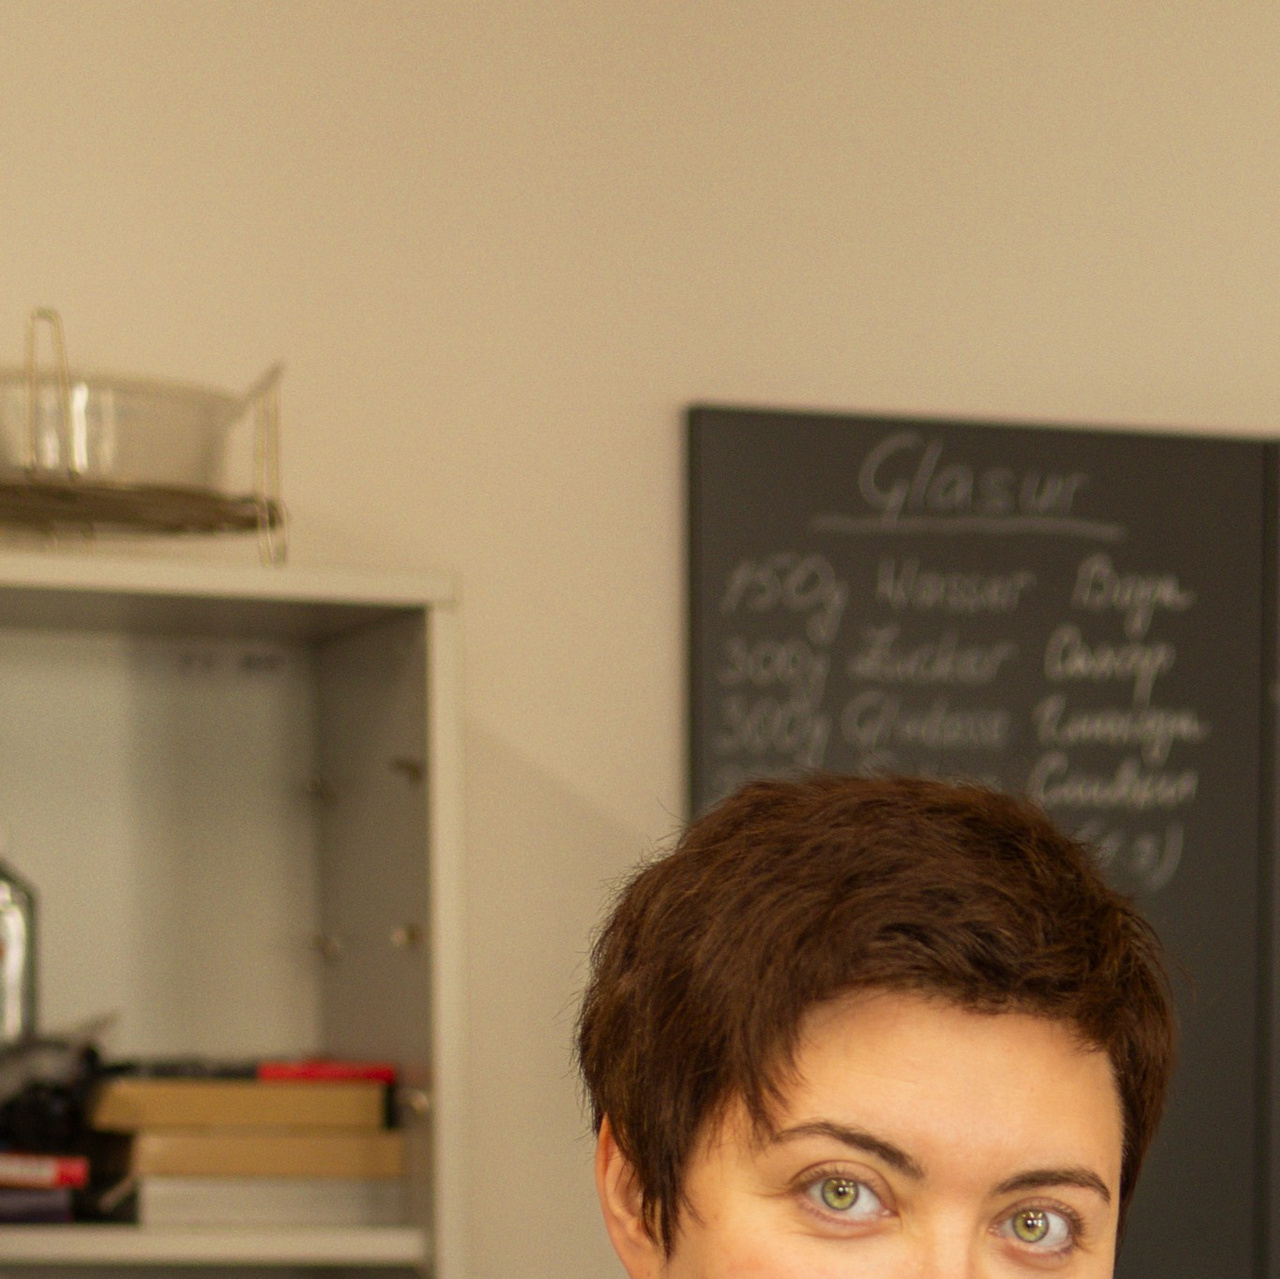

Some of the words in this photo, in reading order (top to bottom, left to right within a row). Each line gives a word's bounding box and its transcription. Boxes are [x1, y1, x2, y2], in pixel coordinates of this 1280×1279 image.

[858, 431, 1090, 524] Glasur
[720, 551, 850, 646] 150g
[876, 557, 1040, 613] Wasser
[848, 622, 1022, 685] Zucker
